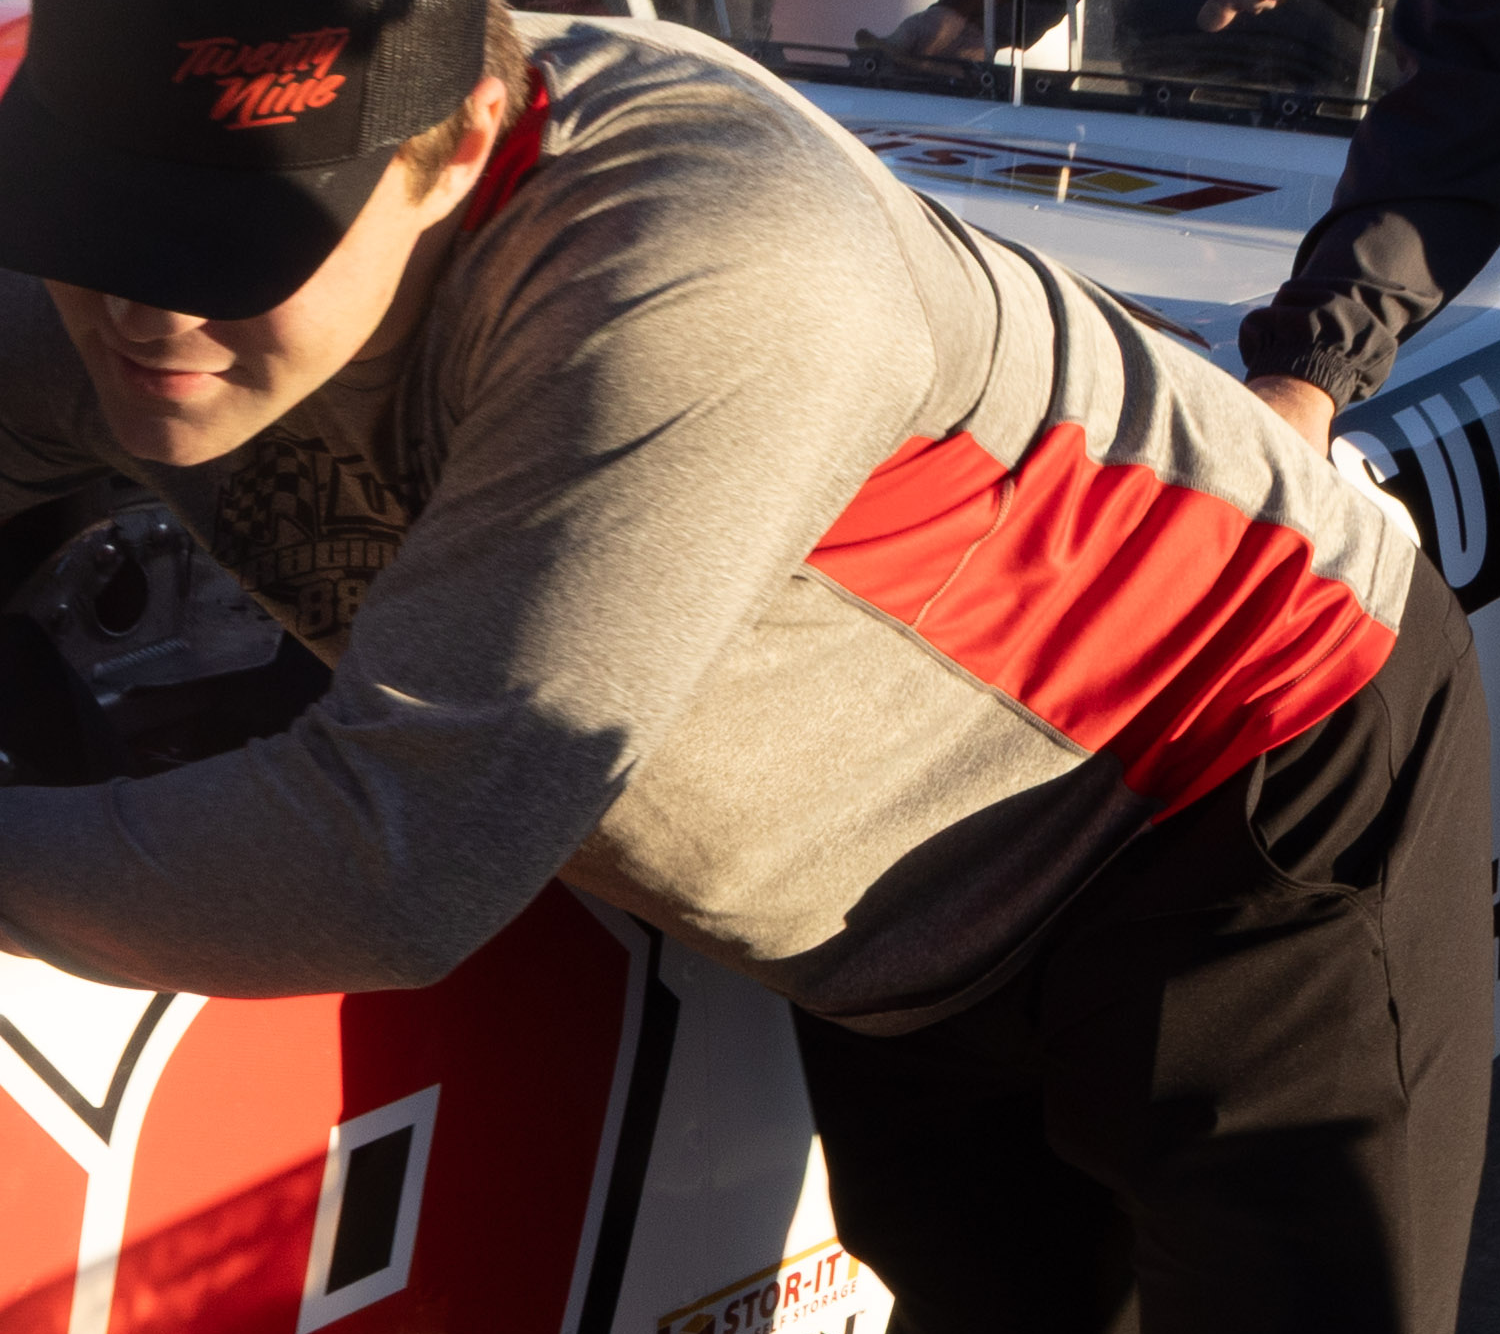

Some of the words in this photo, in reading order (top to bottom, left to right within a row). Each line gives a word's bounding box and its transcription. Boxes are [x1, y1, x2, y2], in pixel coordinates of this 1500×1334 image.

[172, 27, 349, 83] Twenty
[210, 72, 346, 131] Nine
[793, 1280, 858, 1323] STORAGE
